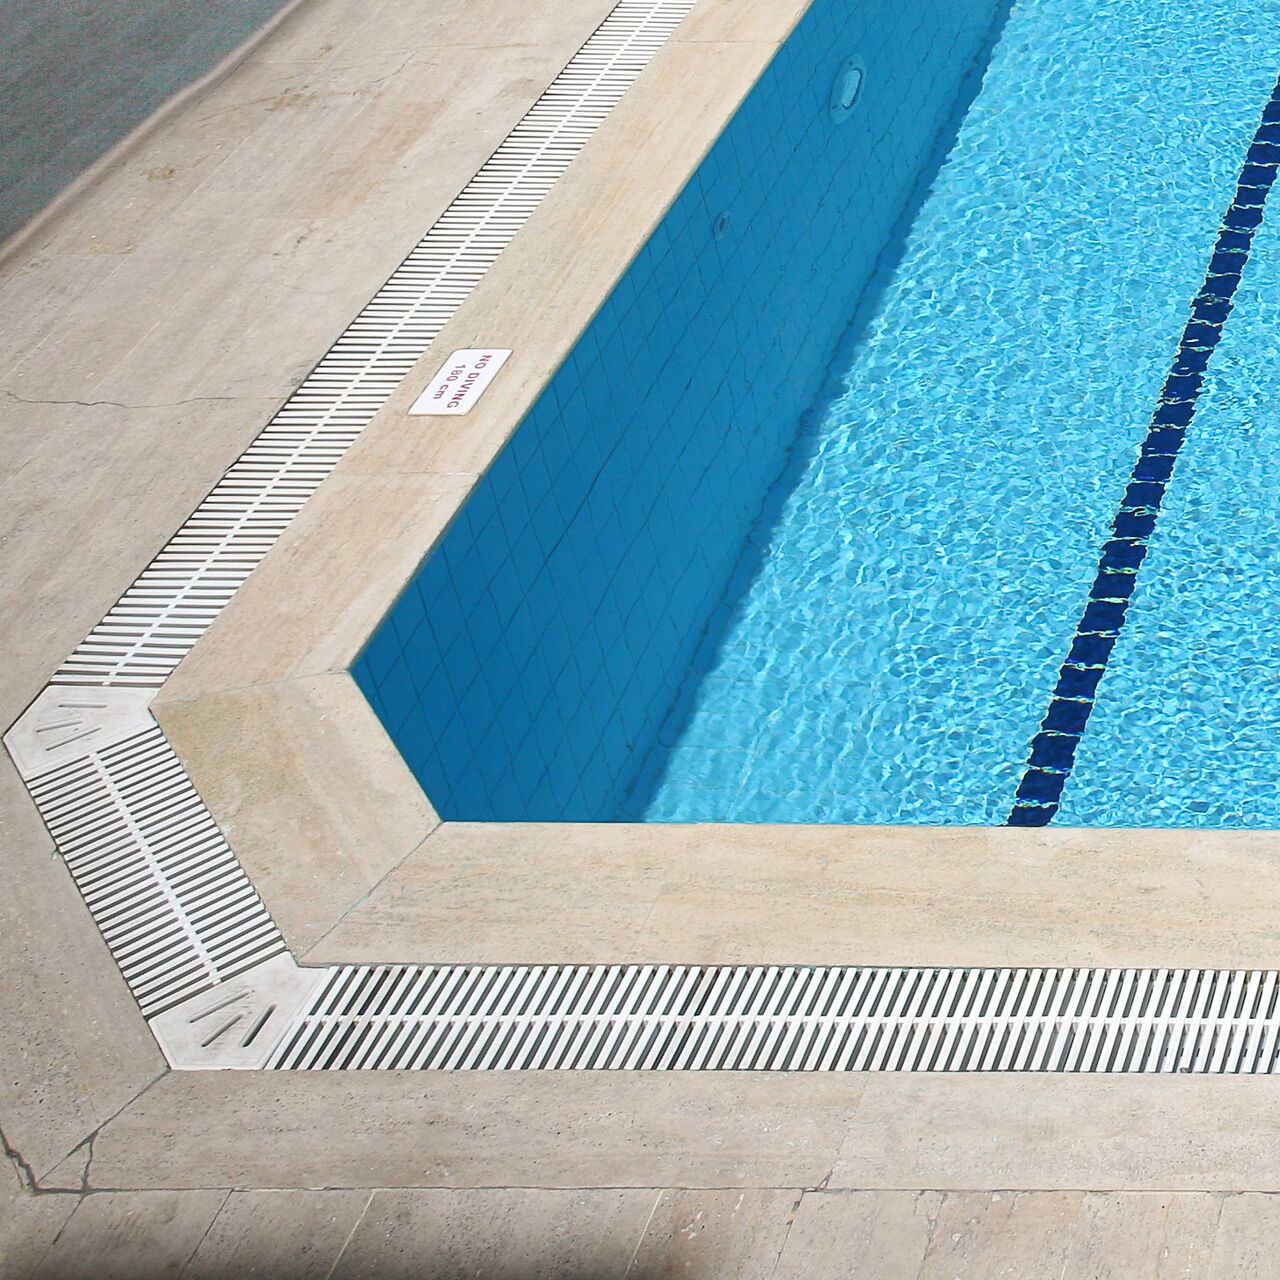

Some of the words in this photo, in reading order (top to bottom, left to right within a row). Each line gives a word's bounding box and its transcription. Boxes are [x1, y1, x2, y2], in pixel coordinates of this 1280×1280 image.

[474, 354, 493, 370] NO
[446, 364, 467, 382] 180
[432, 384, 449, 400] cm
[446, 372, 480, 409] DIVING
